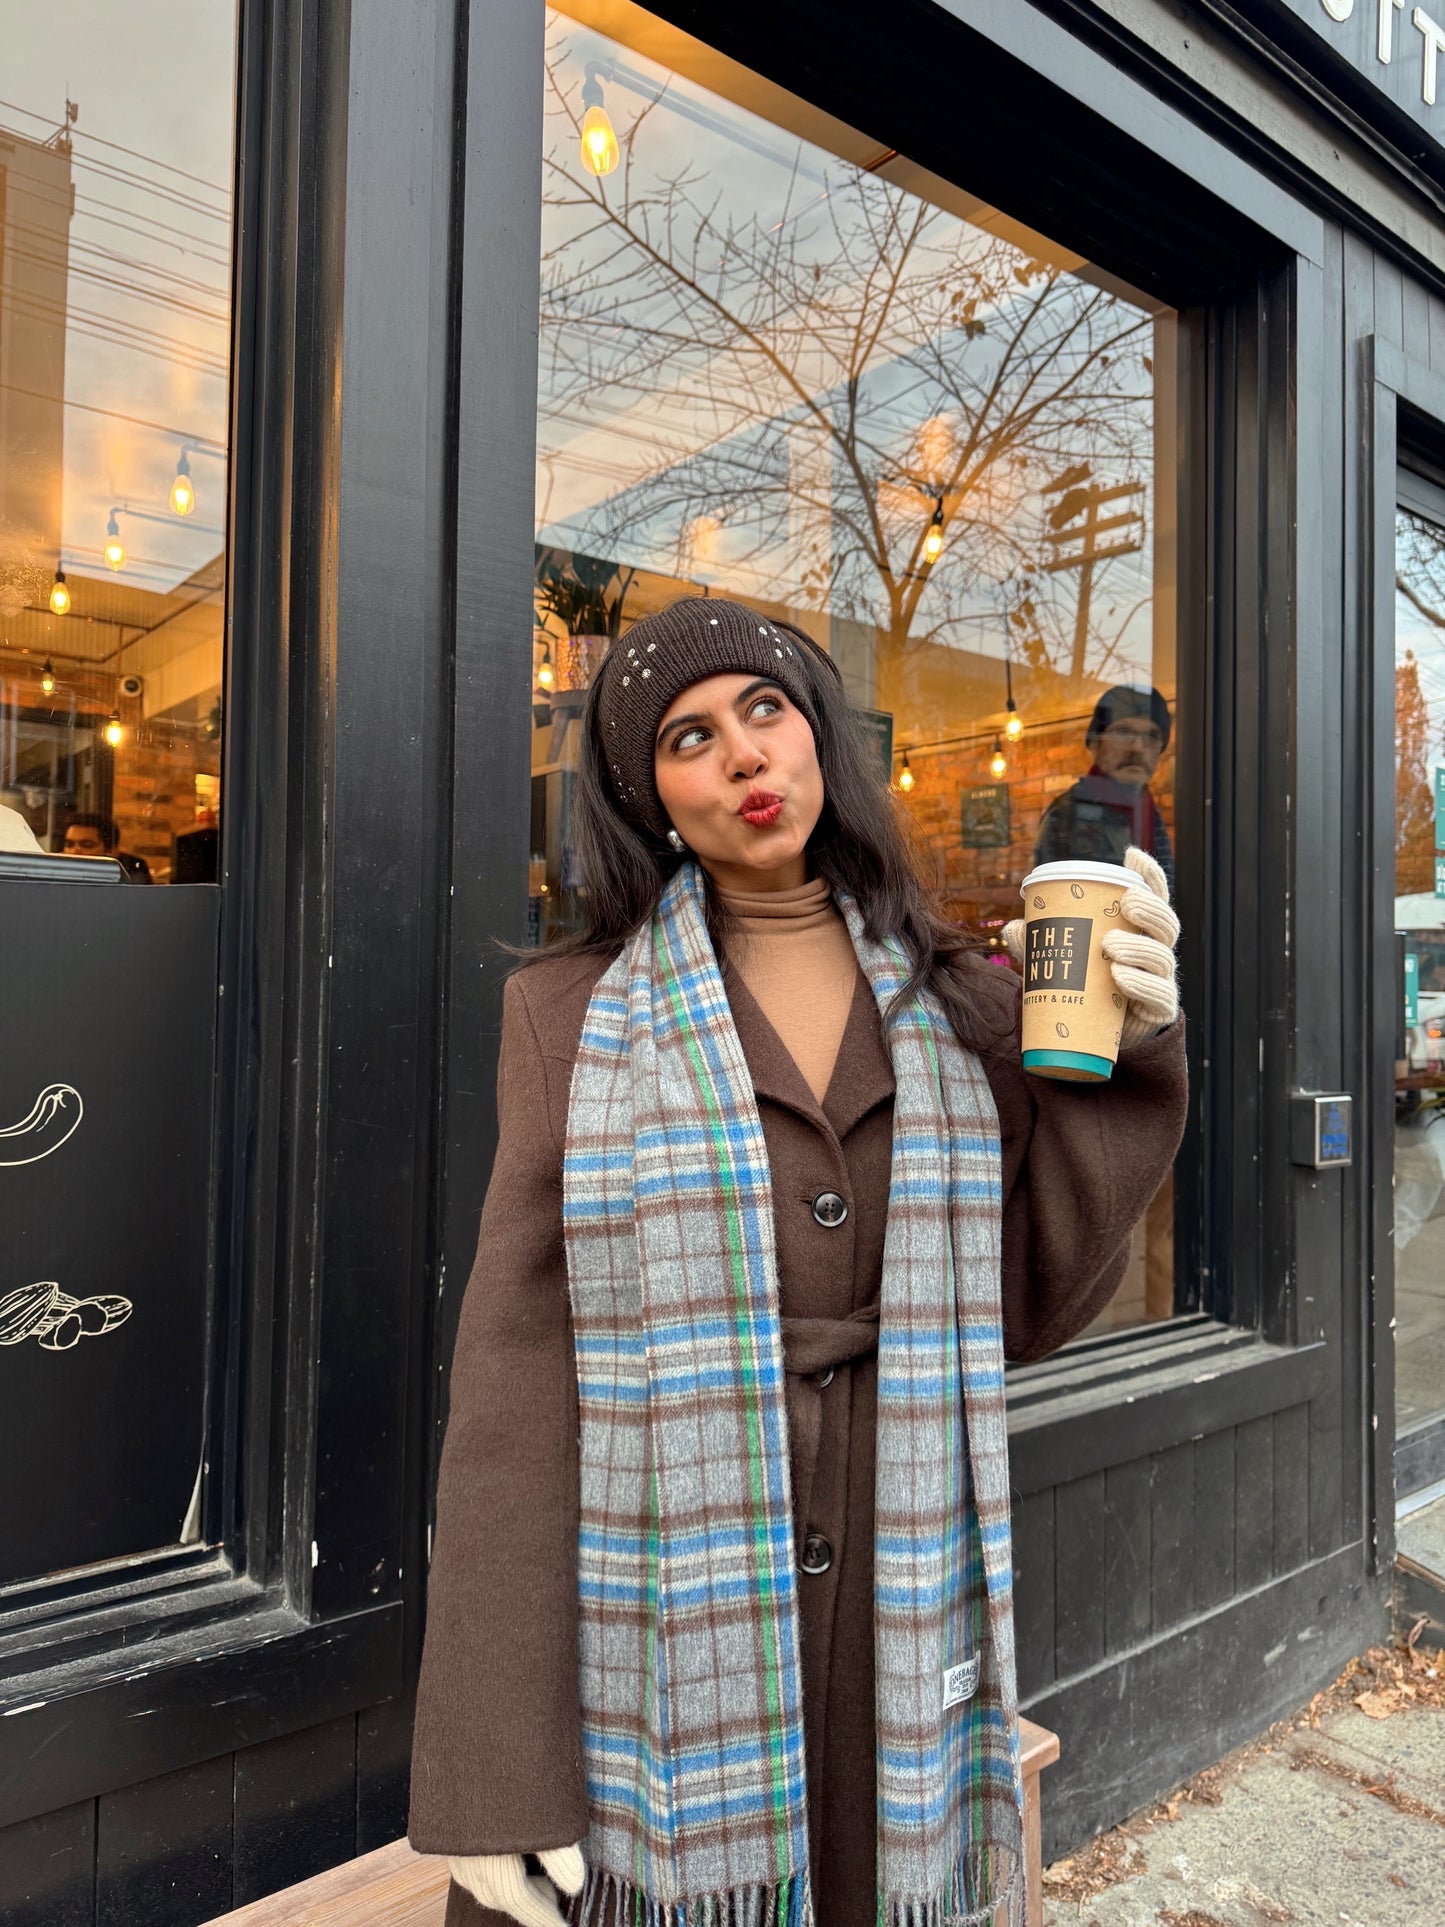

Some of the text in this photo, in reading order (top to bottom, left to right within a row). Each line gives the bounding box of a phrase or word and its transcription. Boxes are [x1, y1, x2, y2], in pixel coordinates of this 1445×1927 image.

[1321, 0, 1445, 106] TT
[1031, 927, 1074, 948] THE
[1031, 948, 1073, 960] ROASTED
[1030, 960, 1072, 981] NUT
[1050, 994, 1057, 1003] &
[1061, 995, 1085, 1005] CAFÉ
